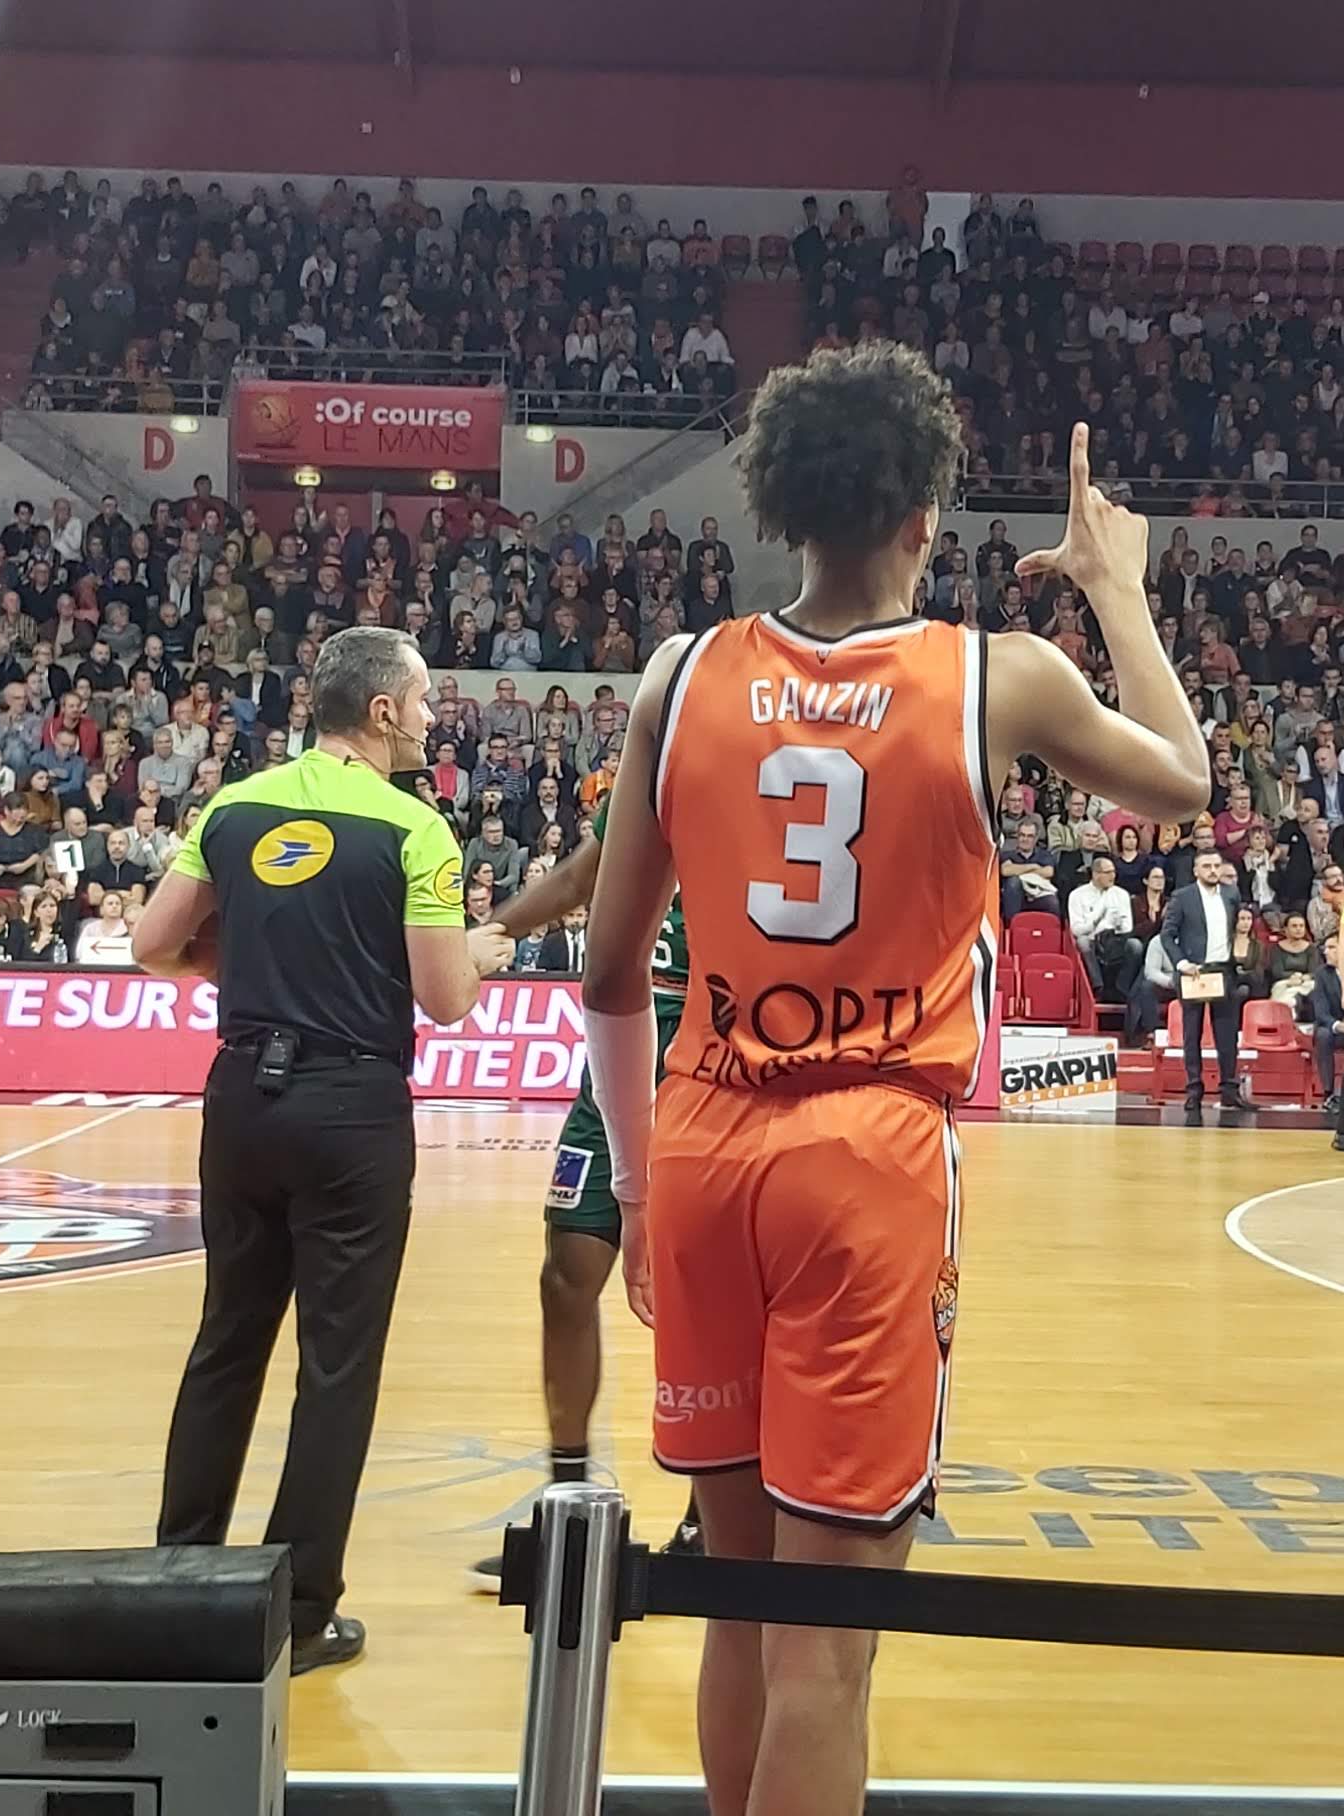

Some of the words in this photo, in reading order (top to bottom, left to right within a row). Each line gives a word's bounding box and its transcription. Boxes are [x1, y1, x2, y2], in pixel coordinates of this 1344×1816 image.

[371, 403, 473, 428] course
[143, 427, 175, 471] D
[323, 425, 358, 453] LE
[377, 426, 472, 455] MANS
[555, 439, 586, 483] D
[748, 676, 894, 733] GAUZIN
[62, 844, 77, 869] 1
[747, 743, 867, 947] 3
[54, 977, 179, 1031] SUR
[750, 983, 924, 1054] OPTI
[1001, 1053, 1117, 1095] GRAPHI
